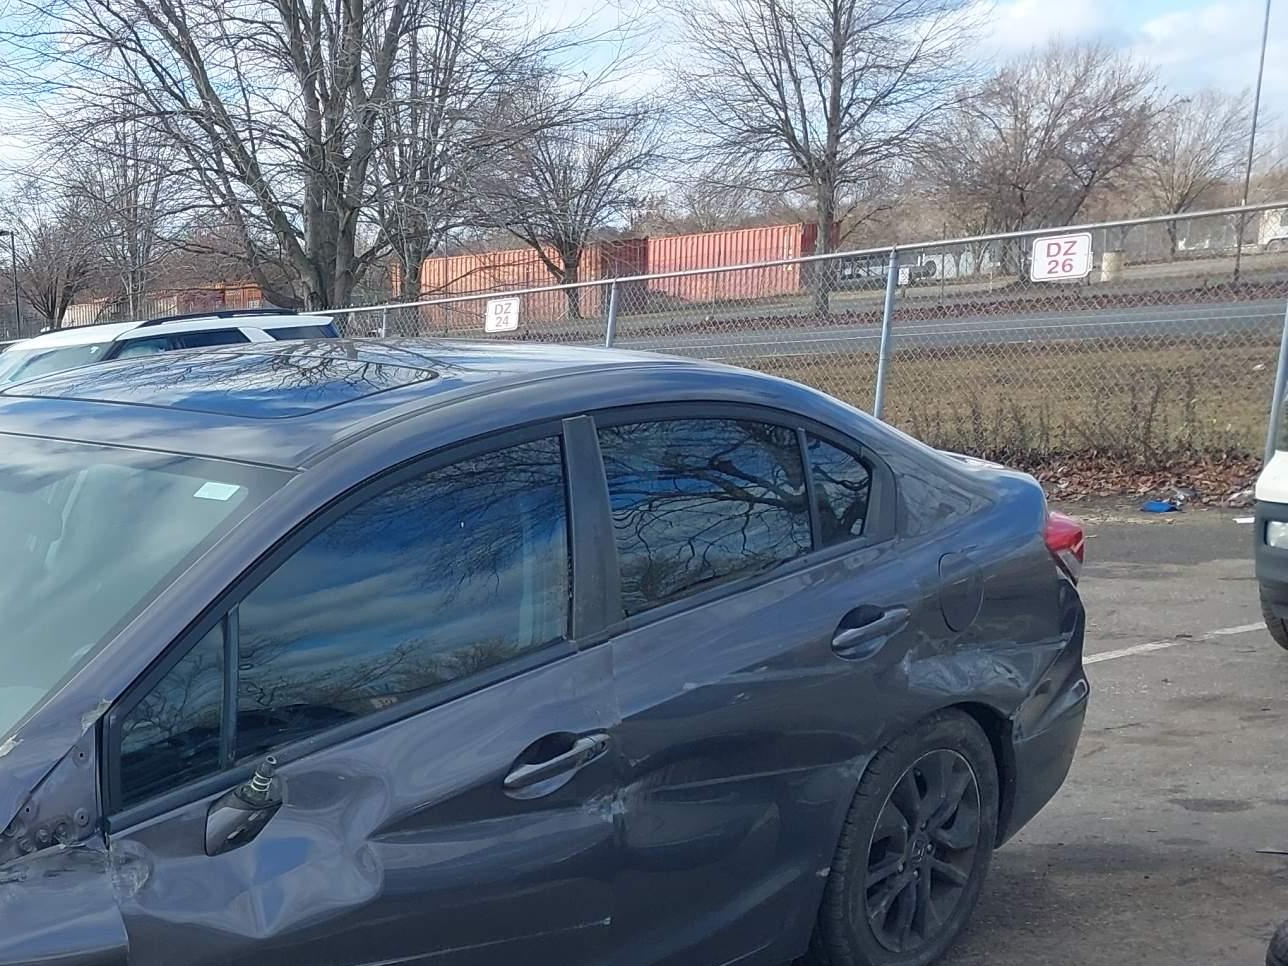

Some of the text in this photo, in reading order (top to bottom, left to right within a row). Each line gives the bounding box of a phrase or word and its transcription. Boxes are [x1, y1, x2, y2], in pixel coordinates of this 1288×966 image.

[1046, 240, 1078, 258] DZ
[1047, 258, 1074, 274] 26
[494, 303, 512, 315] DZ
[495, 315, 509, 327] 24
